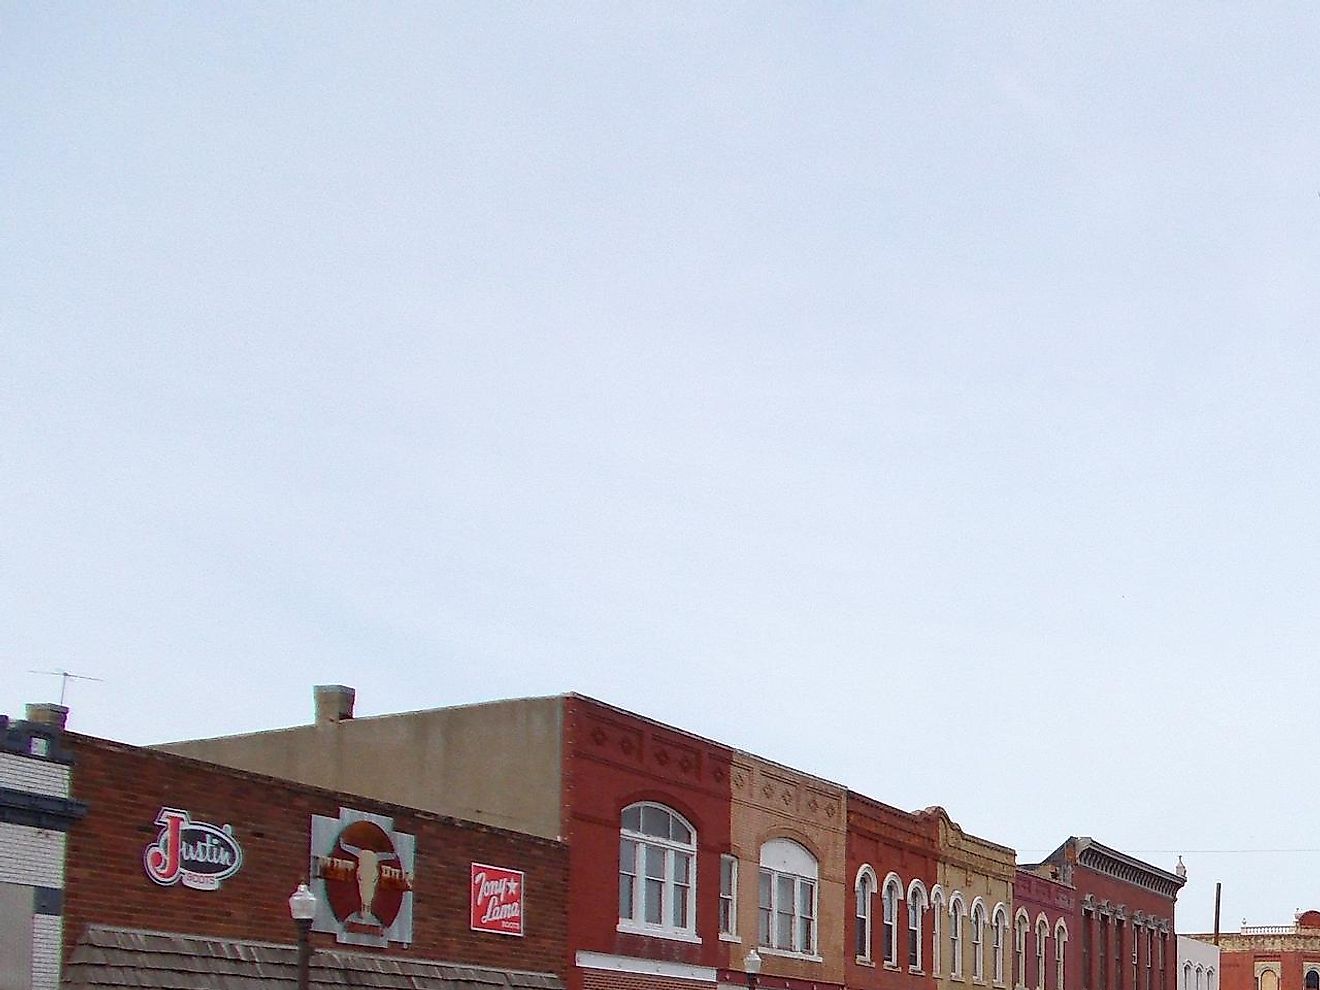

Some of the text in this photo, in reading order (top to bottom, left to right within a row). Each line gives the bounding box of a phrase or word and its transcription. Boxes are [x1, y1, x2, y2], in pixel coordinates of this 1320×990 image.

[148, 812, 232, 880] Justin
[187, 873, 216, 885] BOOTS
[475, 872, 508, 906] Tony
[481, 896, 520, 923] Lama
